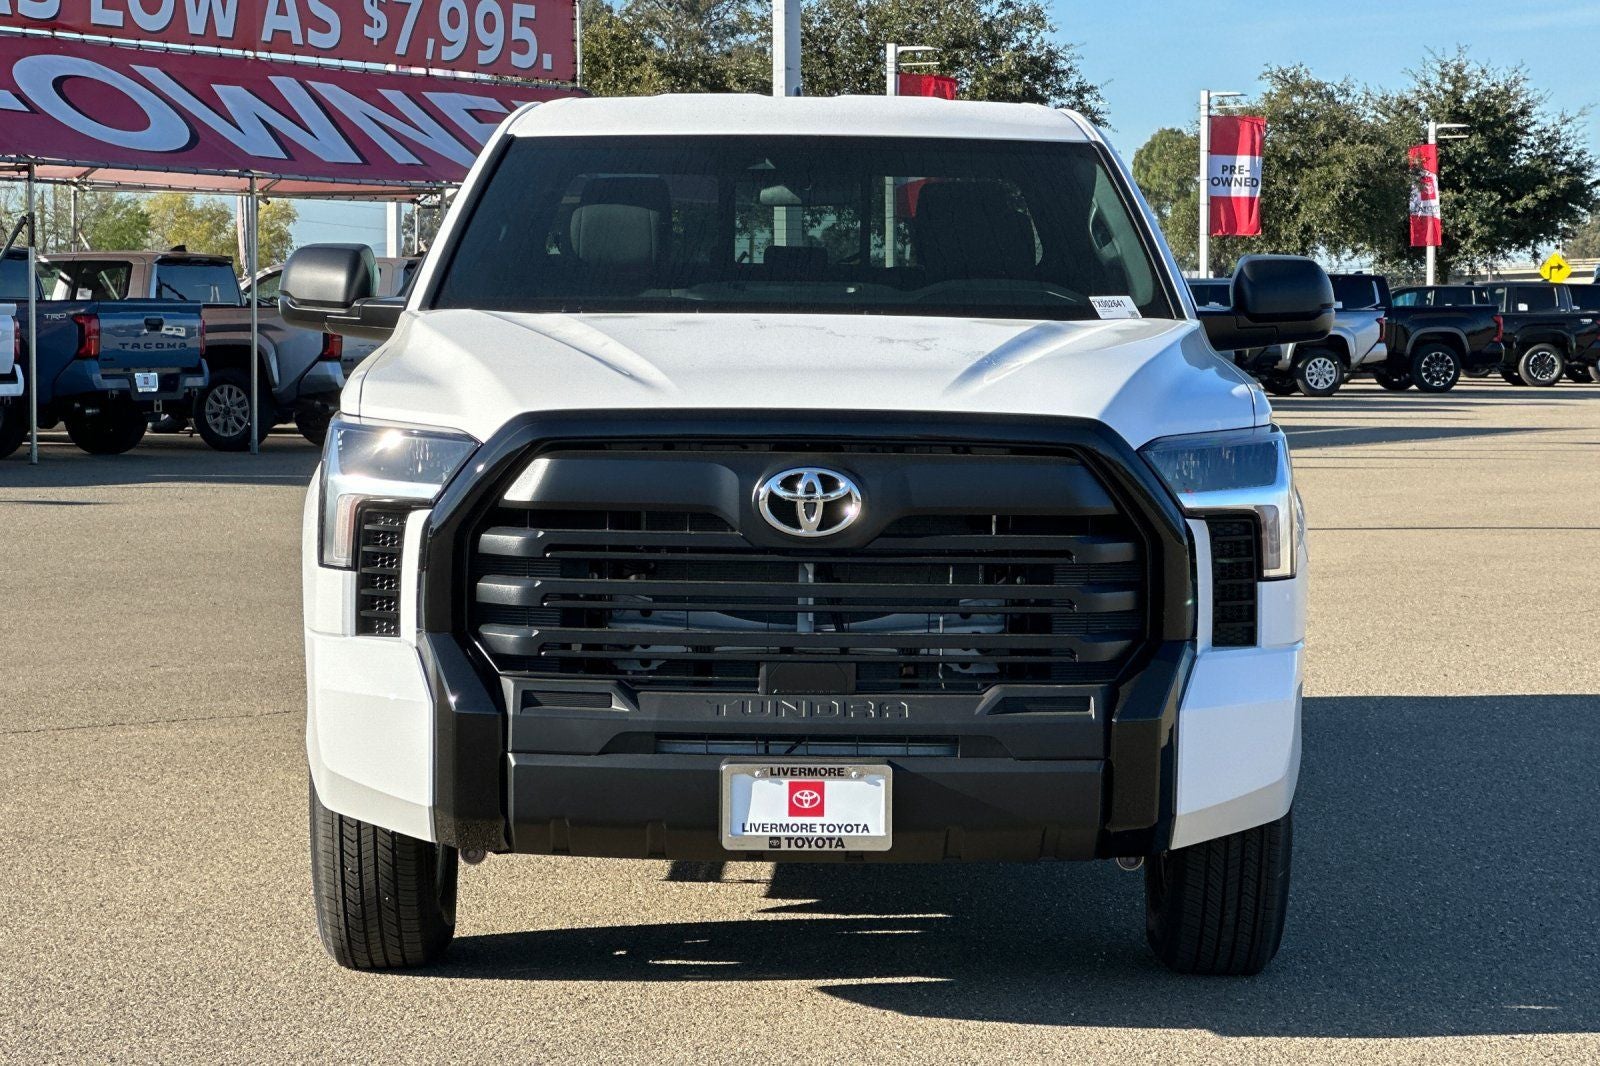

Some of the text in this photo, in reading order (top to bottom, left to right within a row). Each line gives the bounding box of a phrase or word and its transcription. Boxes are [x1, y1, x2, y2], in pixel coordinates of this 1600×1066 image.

[261, 0, 342, 49] AS
[1221, 164, 1250, 175] PRE-
[1210, 176, 1259, 188] OWNED
[118, 342, 188, 350] TACOMA
[706, 700, 909, 719] TUNDRA
[769, 767, 845, 777] LIVERMORE
[741, 822, 870, 834] LIVERMORE TOYOTA
[785, 837, 845, 849] TOYOTA
